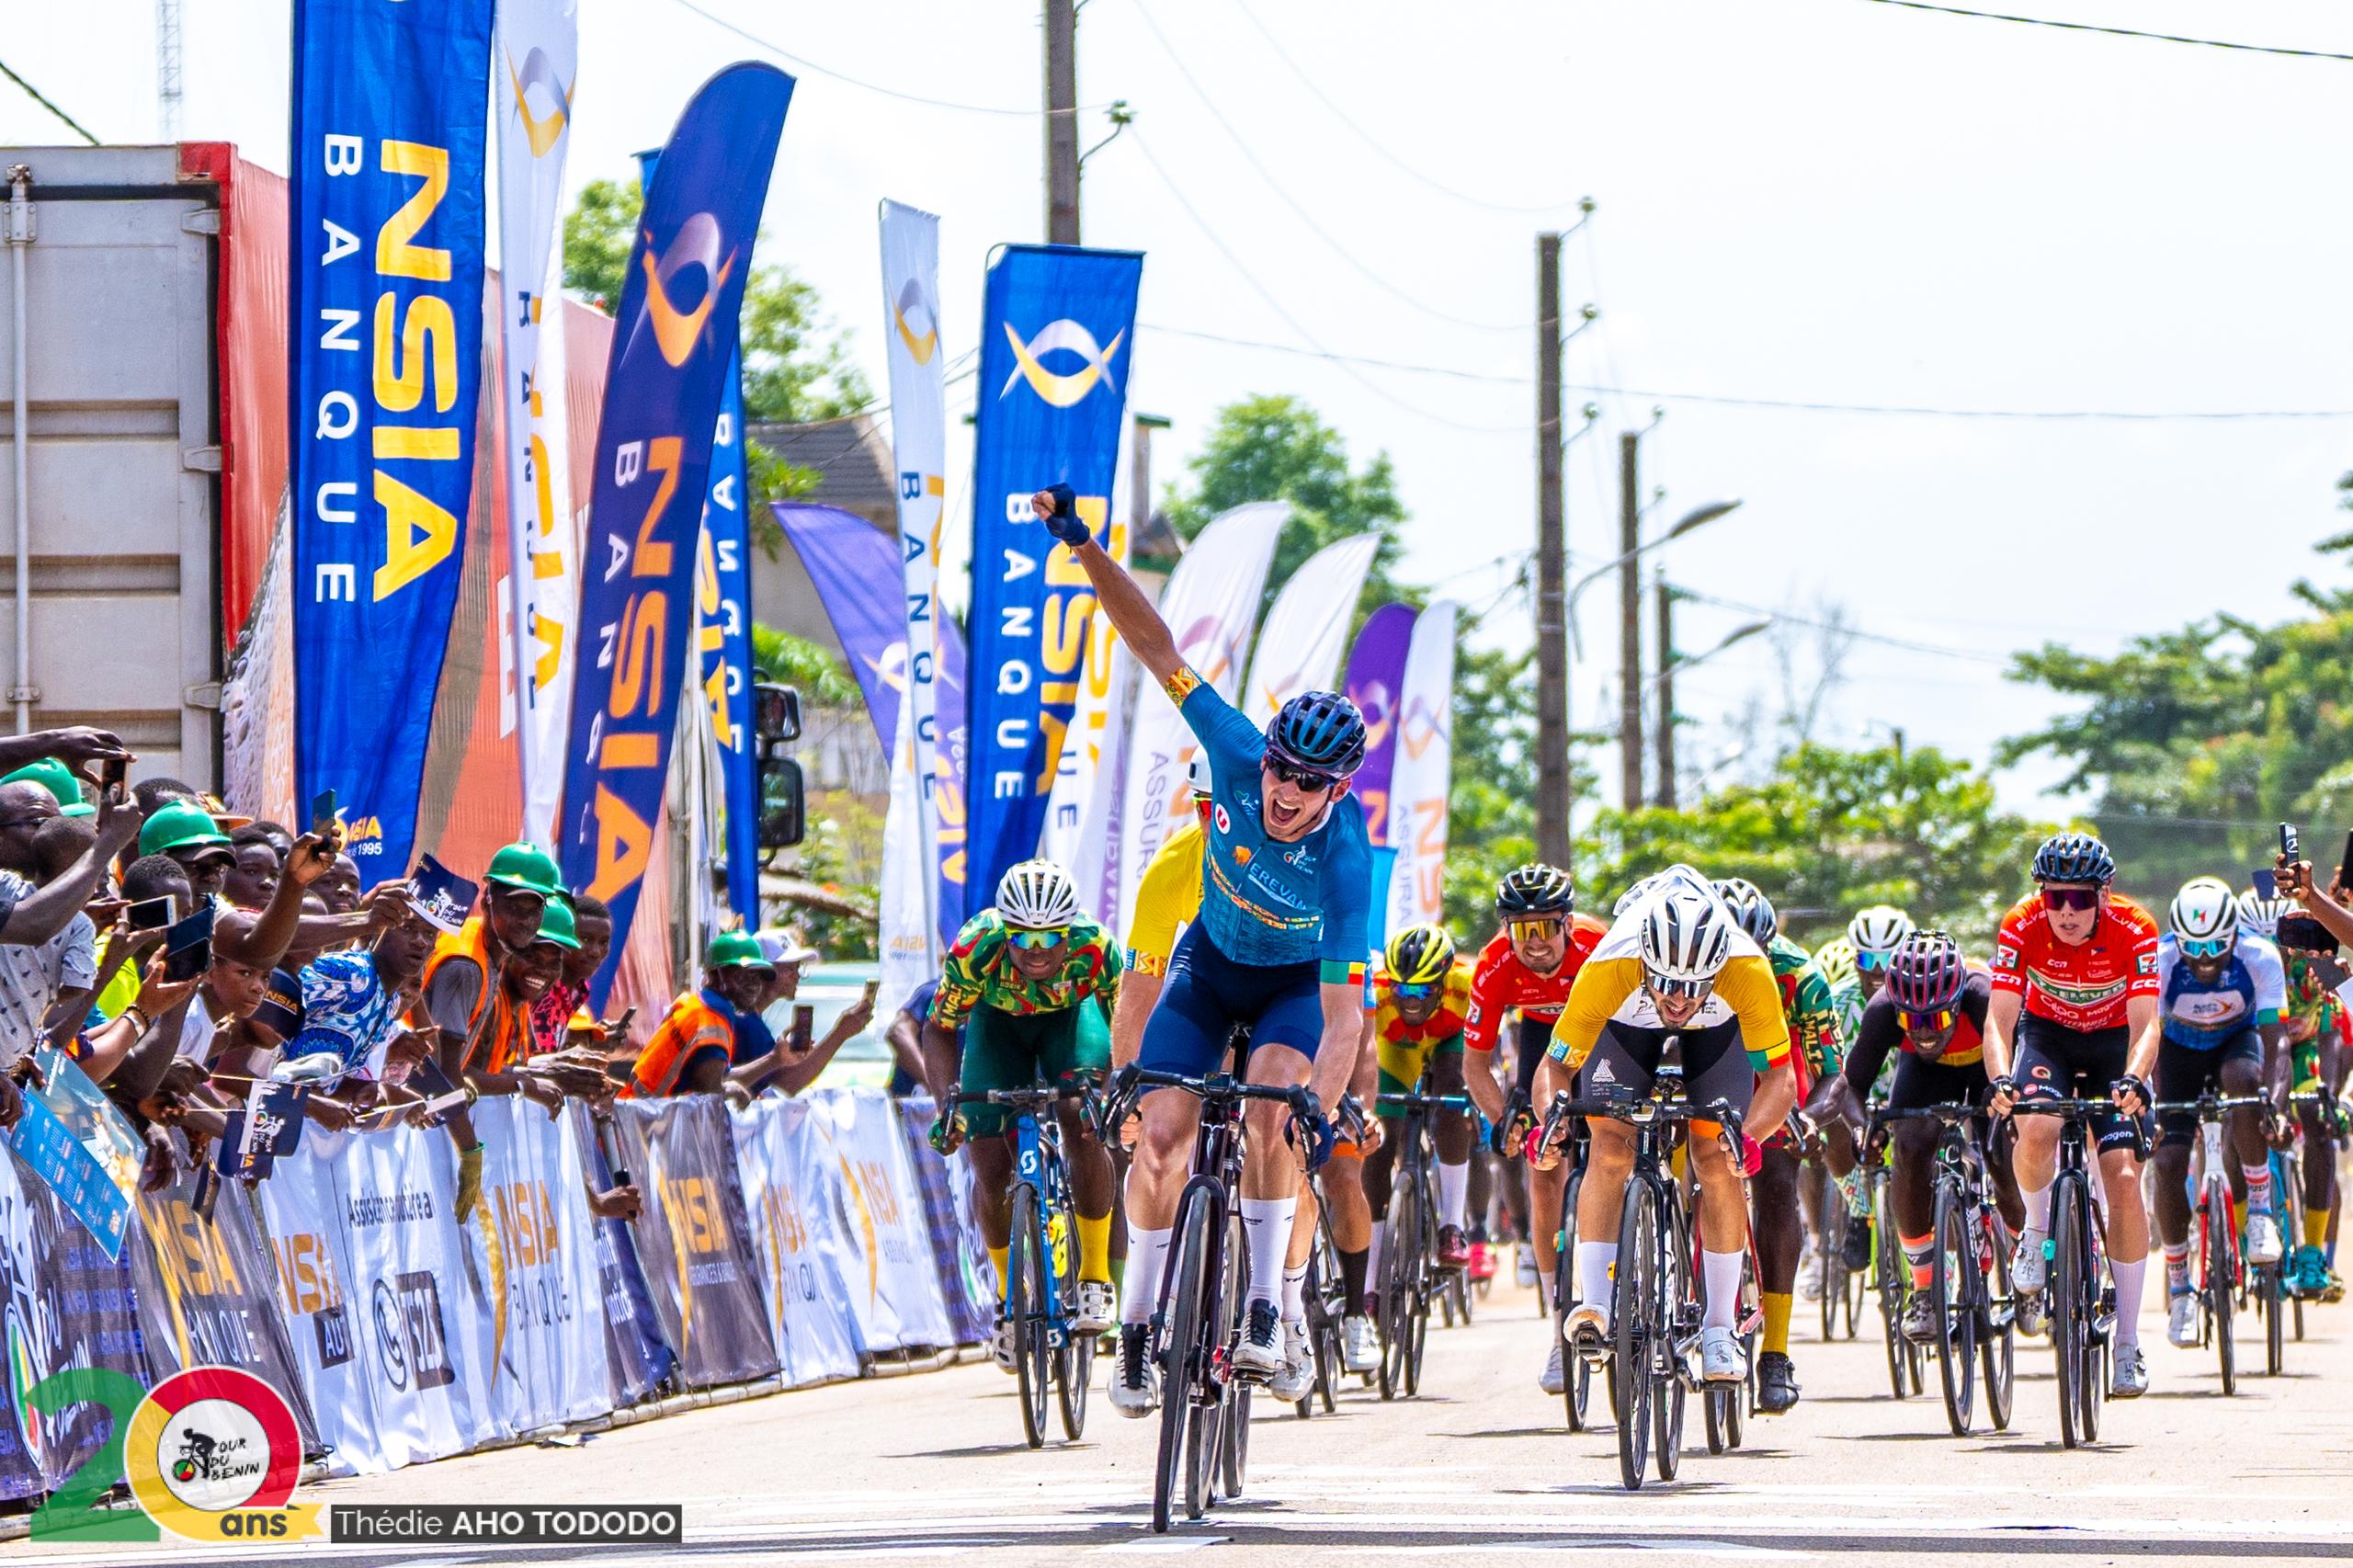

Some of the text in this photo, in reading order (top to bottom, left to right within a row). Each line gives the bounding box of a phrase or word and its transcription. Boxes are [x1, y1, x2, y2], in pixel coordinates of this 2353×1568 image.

[315, 133, 363, 603] BANQUE
[373, 139, 460, 603] NSIA
[585, 436, 683, 904] NSIA
[995, 493, 1037, 799] BANQUE
[358, 842, 383, 856] 1995
[1803, 1017, 1825, 1062] MALI
[494, 1179, 559, 1270] NSIA
